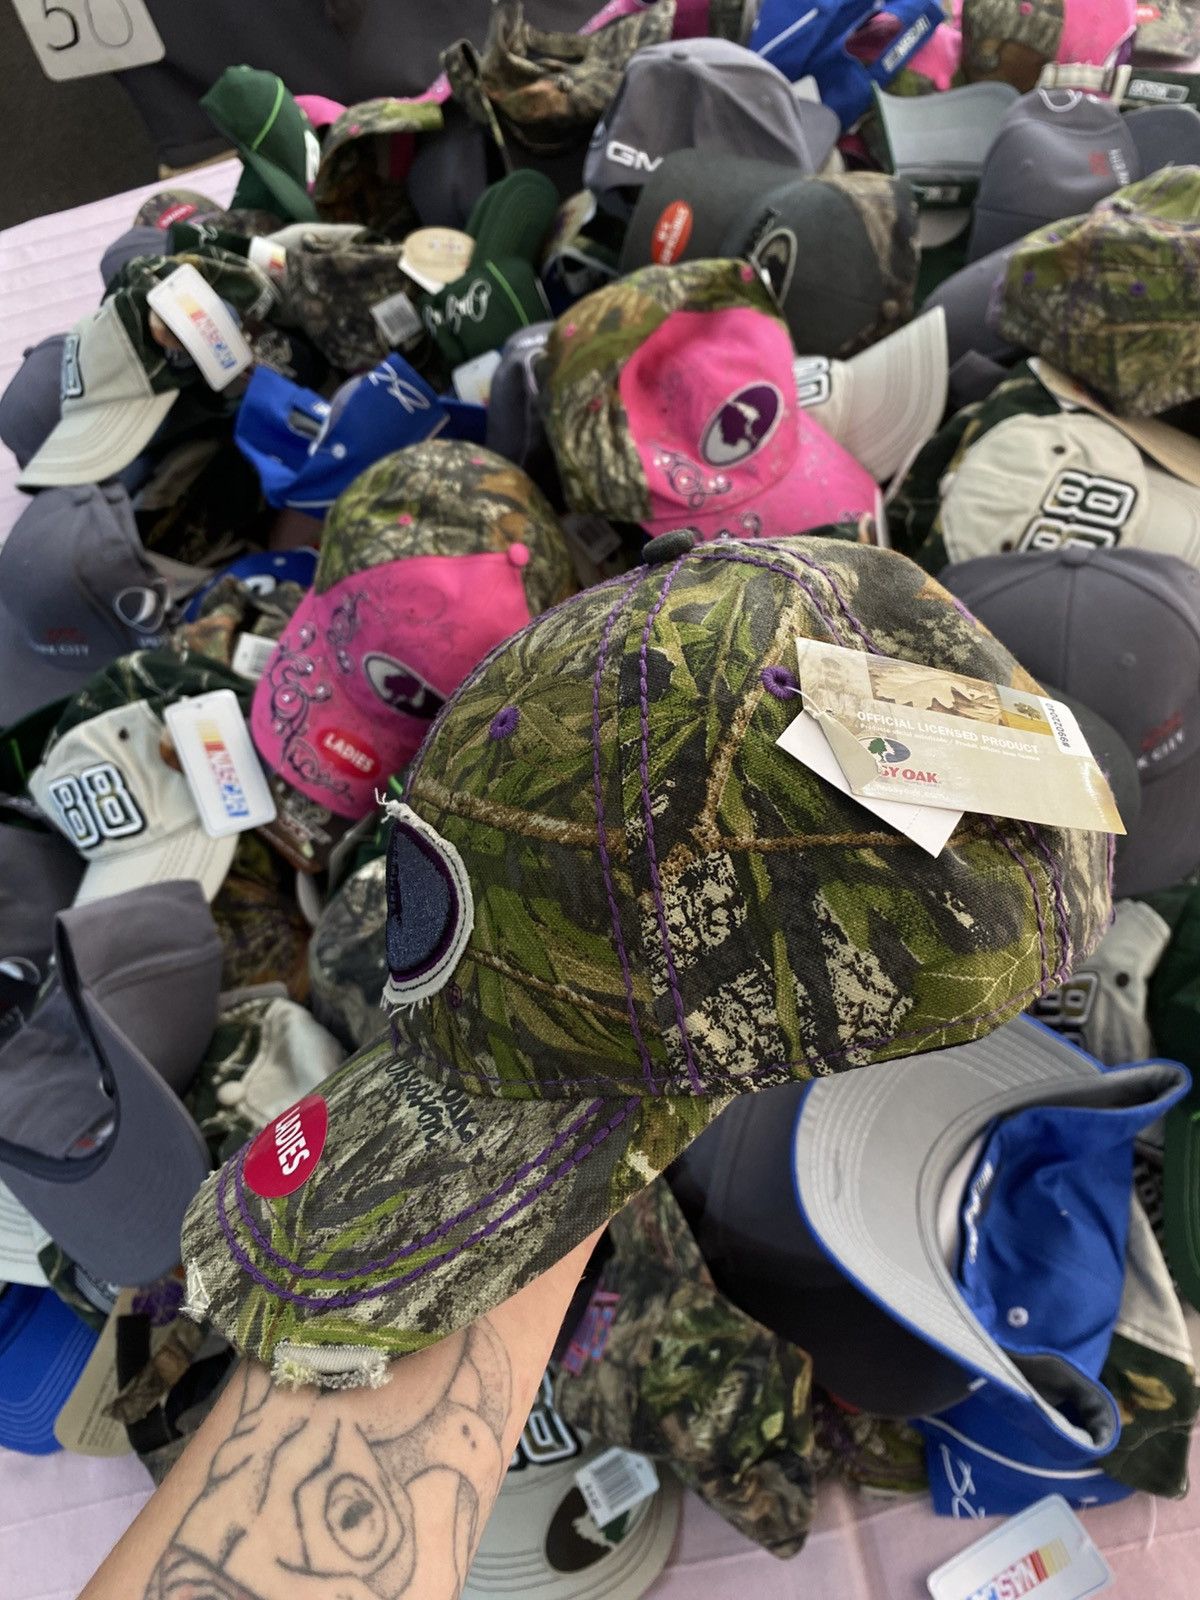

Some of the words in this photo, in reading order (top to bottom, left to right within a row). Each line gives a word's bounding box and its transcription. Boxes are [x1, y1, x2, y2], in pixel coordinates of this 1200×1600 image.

[323, 731, 375, 773] LADIES
[857, 710, 915, 730] OFFICIAL
[918, 722, 979, 741] LICENSED
[981, 734, 1039, 753] PRODUCT
[901, 768, 938, 783] OAK
[50, 761, 145, 849] 88
[275, 1106, 310, 1176] LADIES
